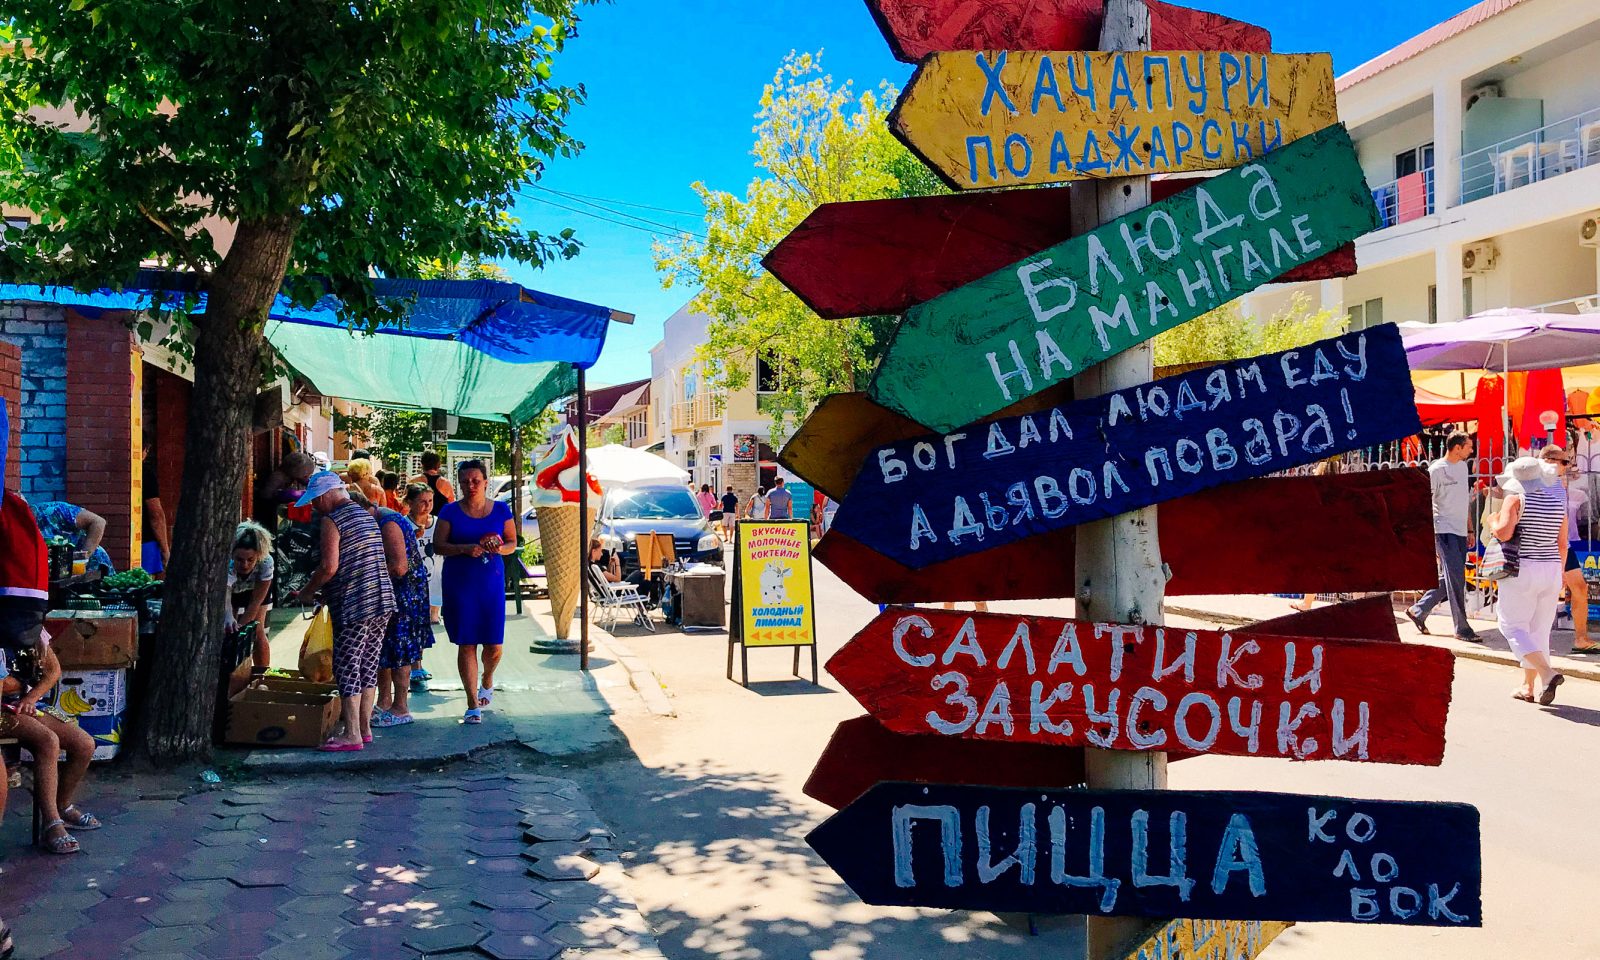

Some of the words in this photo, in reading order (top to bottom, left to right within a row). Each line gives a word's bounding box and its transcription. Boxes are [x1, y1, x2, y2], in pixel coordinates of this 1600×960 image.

[977, 49, 1271, 117] ХАЧАПУРИ
[966, 133, 1034, 184] ПО
[1049, 118, 1282, 173] АДЖАРСКИ
[985, 327, 1073, 401] НА
[1087, 213, 1322, 352] МАНГАЛЕ
[878, 432, 967, 484] БОГ
[982, 407, 1074, 461] ДАЛ
[1108, 361, 1267, 427] ЛЮДЯМ
[1280, 333, 1369, 388] ЕДУ
[748, 538, 801, 549] МОЛОЧНЫЕ
[752, 527, 797, 537] ВКУСНЫЕ
[910, 503, 938, 550] А
[751, 548, 800, 560] КОКТЕЙЛИ
[752, 604, 804, 617] ХОЛОДНЫЙ
[754, 617, 802, 627] ЛИМОНАД
[892, 615, 1324, 694] САЛАТИКИ
[926, 672, 1370, 760] ЗАКУСОЧКИ
[1308, 806, 1376, 843] КО
[892, 802, 1266, 912] ПИЦЦА
[1333, 849, 1399, 882] ЛО
[1350, 886, 1469, 923] БОК
